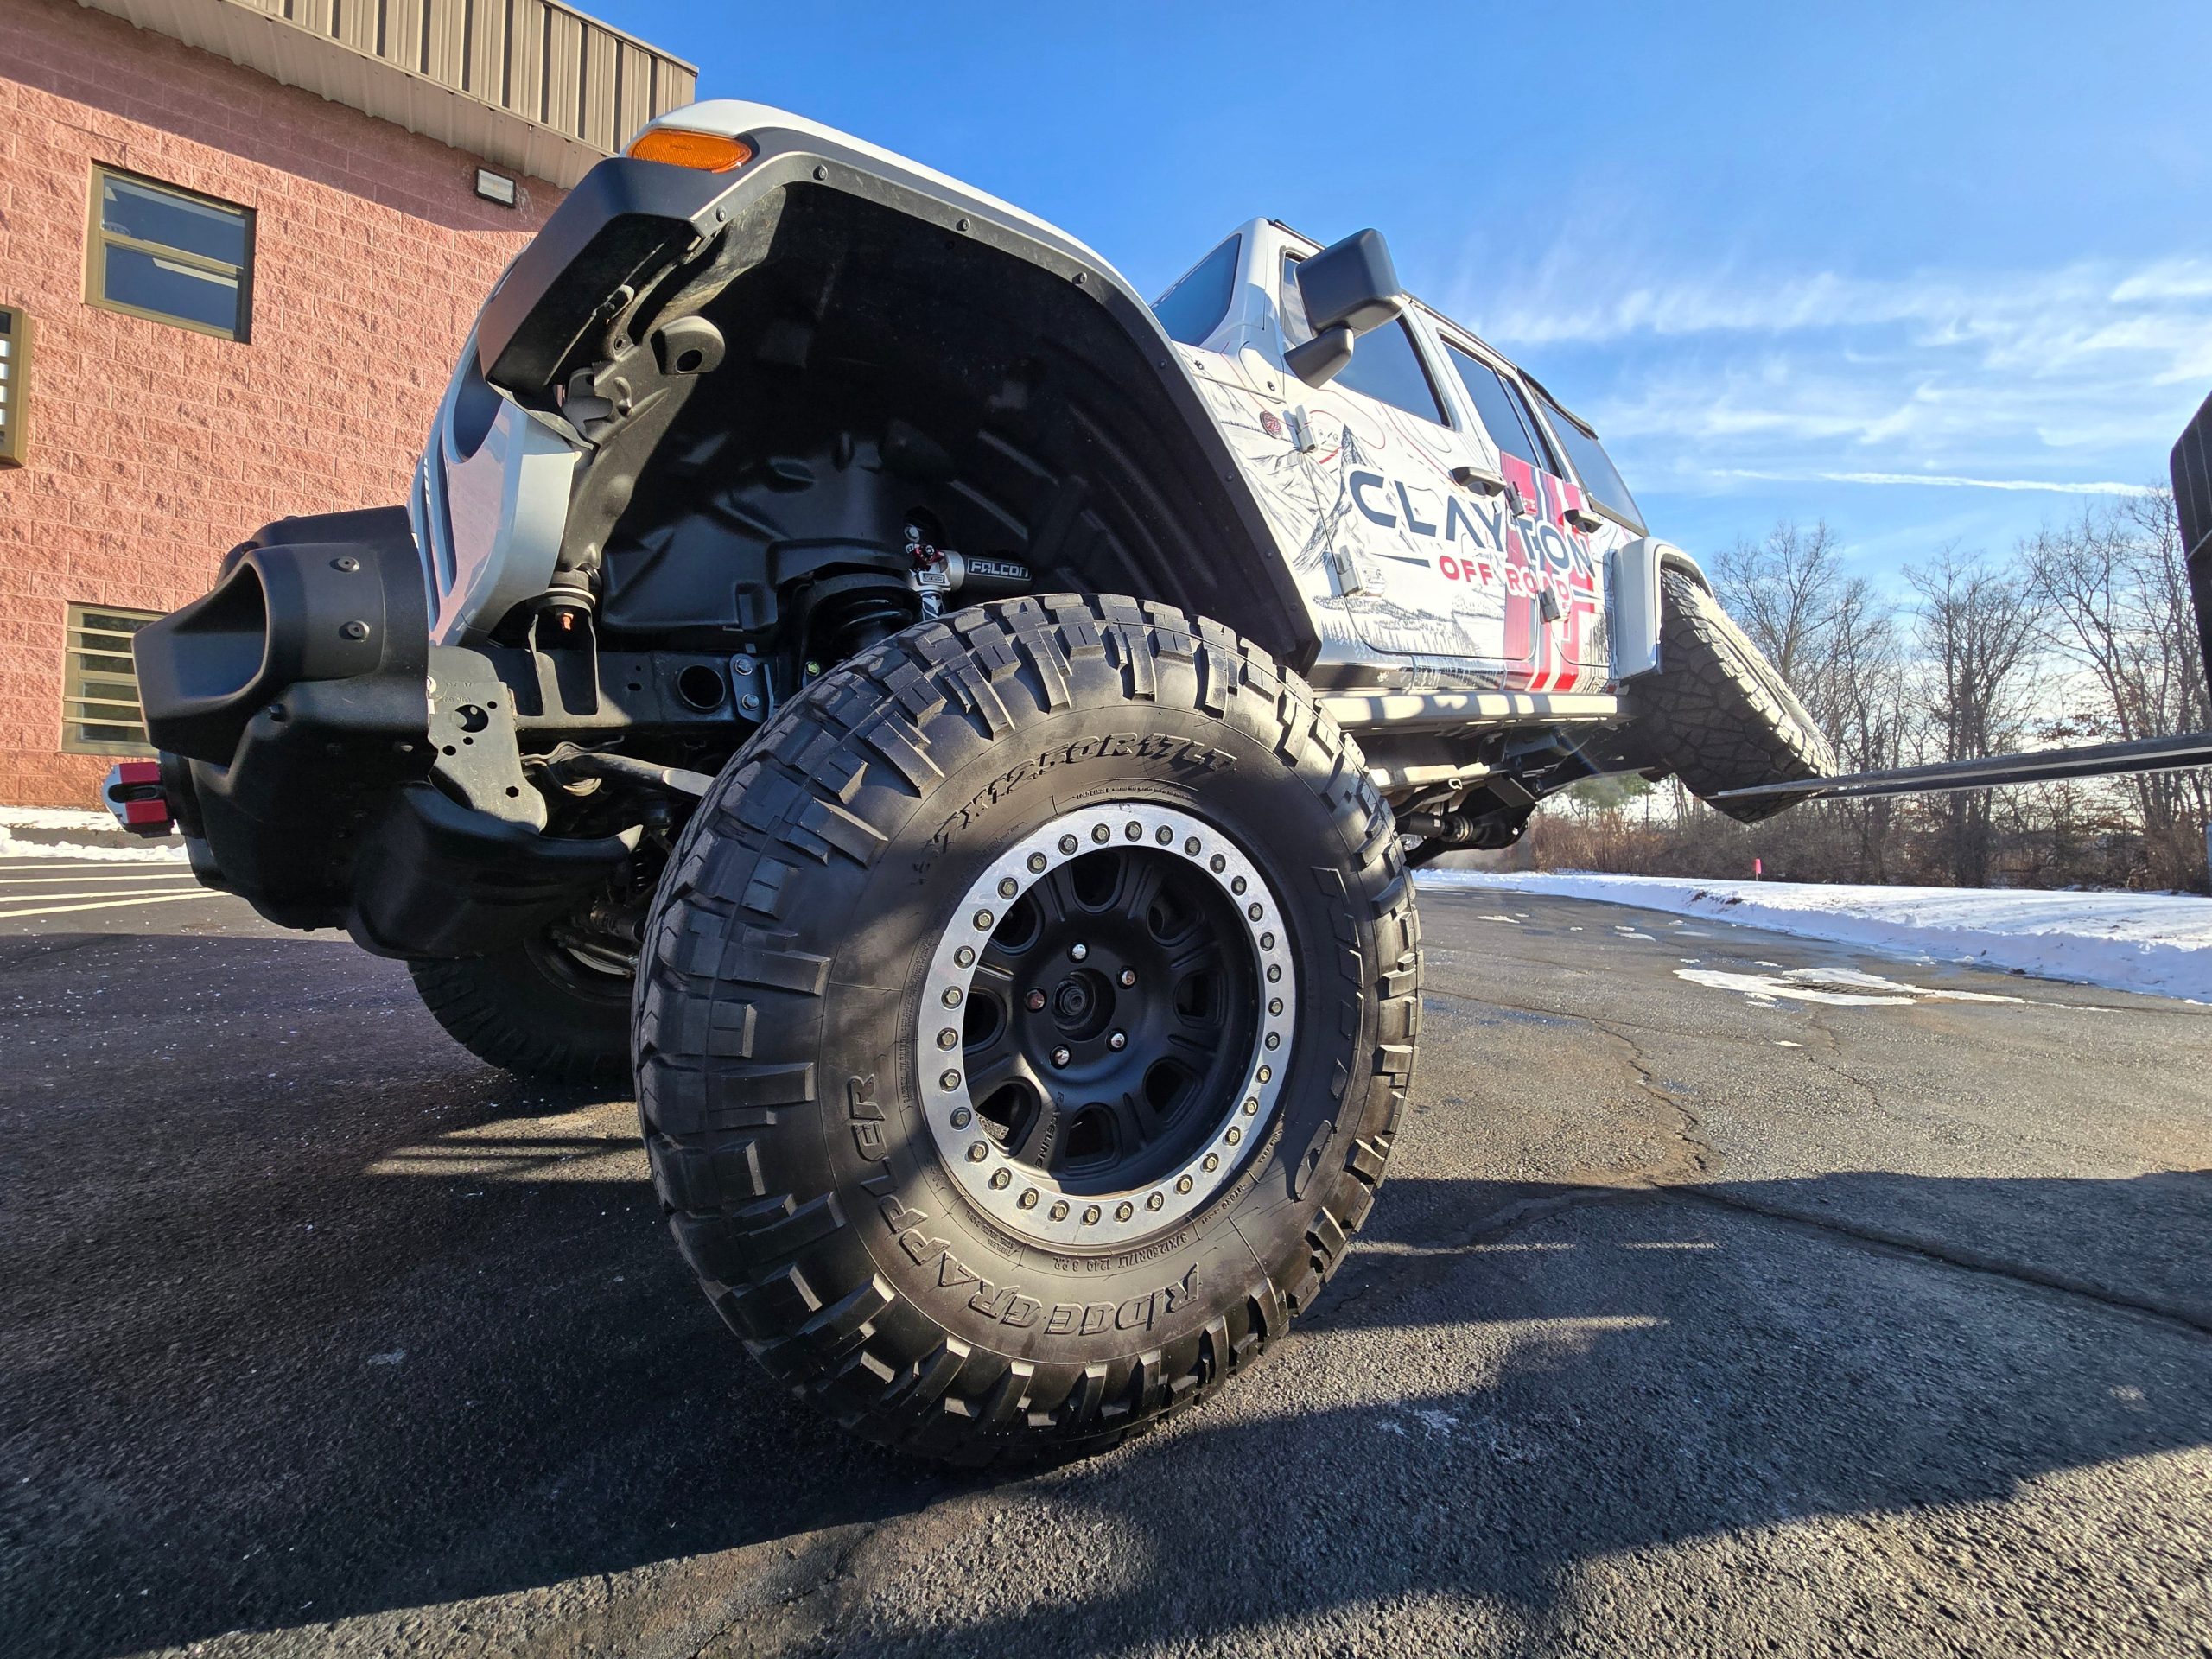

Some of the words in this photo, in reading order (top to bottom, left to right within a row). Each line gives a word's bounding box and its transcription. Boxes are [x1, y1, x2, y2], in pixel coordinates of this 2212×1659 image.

[1350, 470, 1596, 578] CLAYTON
[970, 561, 1029, 578] FALCON
[1439, 555, 1493, 586] OFF
[847, 1073, 1043, 1329] GRAPPLER
[1044, 1262, 1199, 1336] RIDGE
